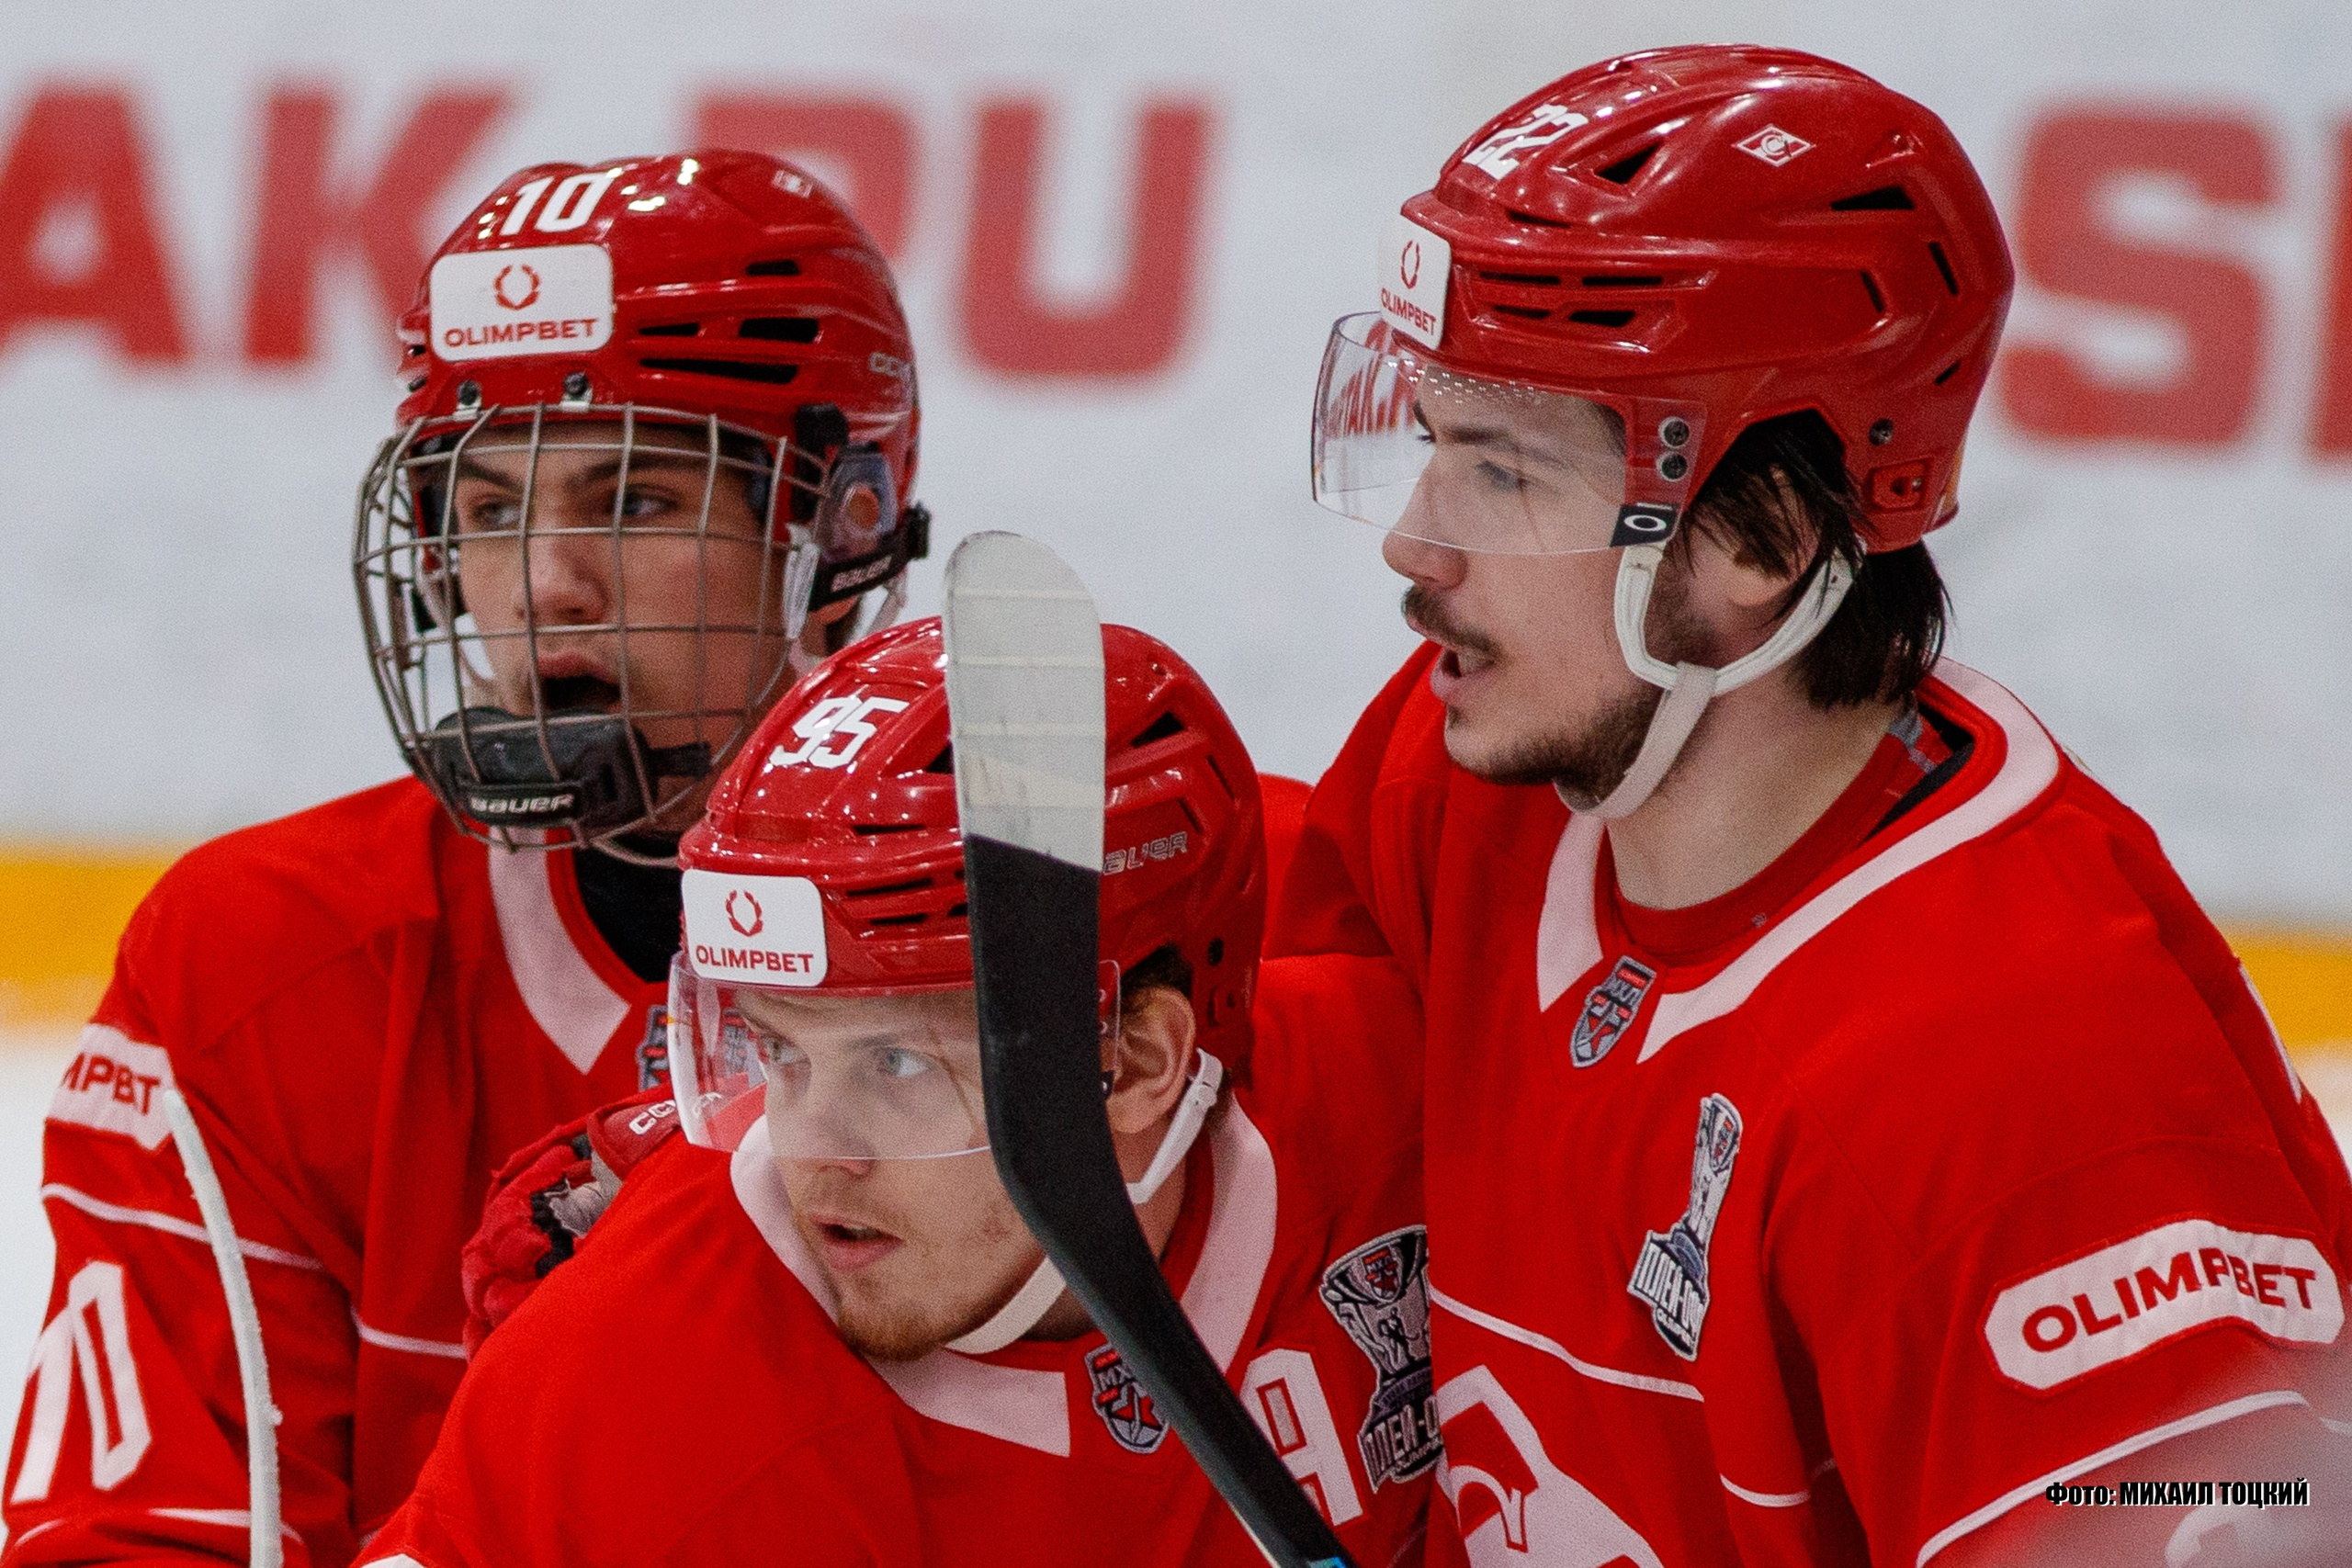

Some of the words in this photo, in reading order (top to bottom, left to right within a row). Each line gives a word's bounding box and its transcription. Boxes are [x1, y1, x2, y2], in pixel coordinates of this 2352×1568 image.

[1462, 103, 1589, 181] 22
[499, 171, 615, 236] 10
[444, 318, 600, 348] OLIMPBET
[1381, 287, 1437, 335] OLIMPBET
[769, 695, 909, 769] 95
[1103, 830, 1188, 876] AUER
[695, 944, 815, 974] OLIMPBET
[2021, 1247, 2316, 1353] OLIMPBET
[9, 1261, 153, 1506] 10
